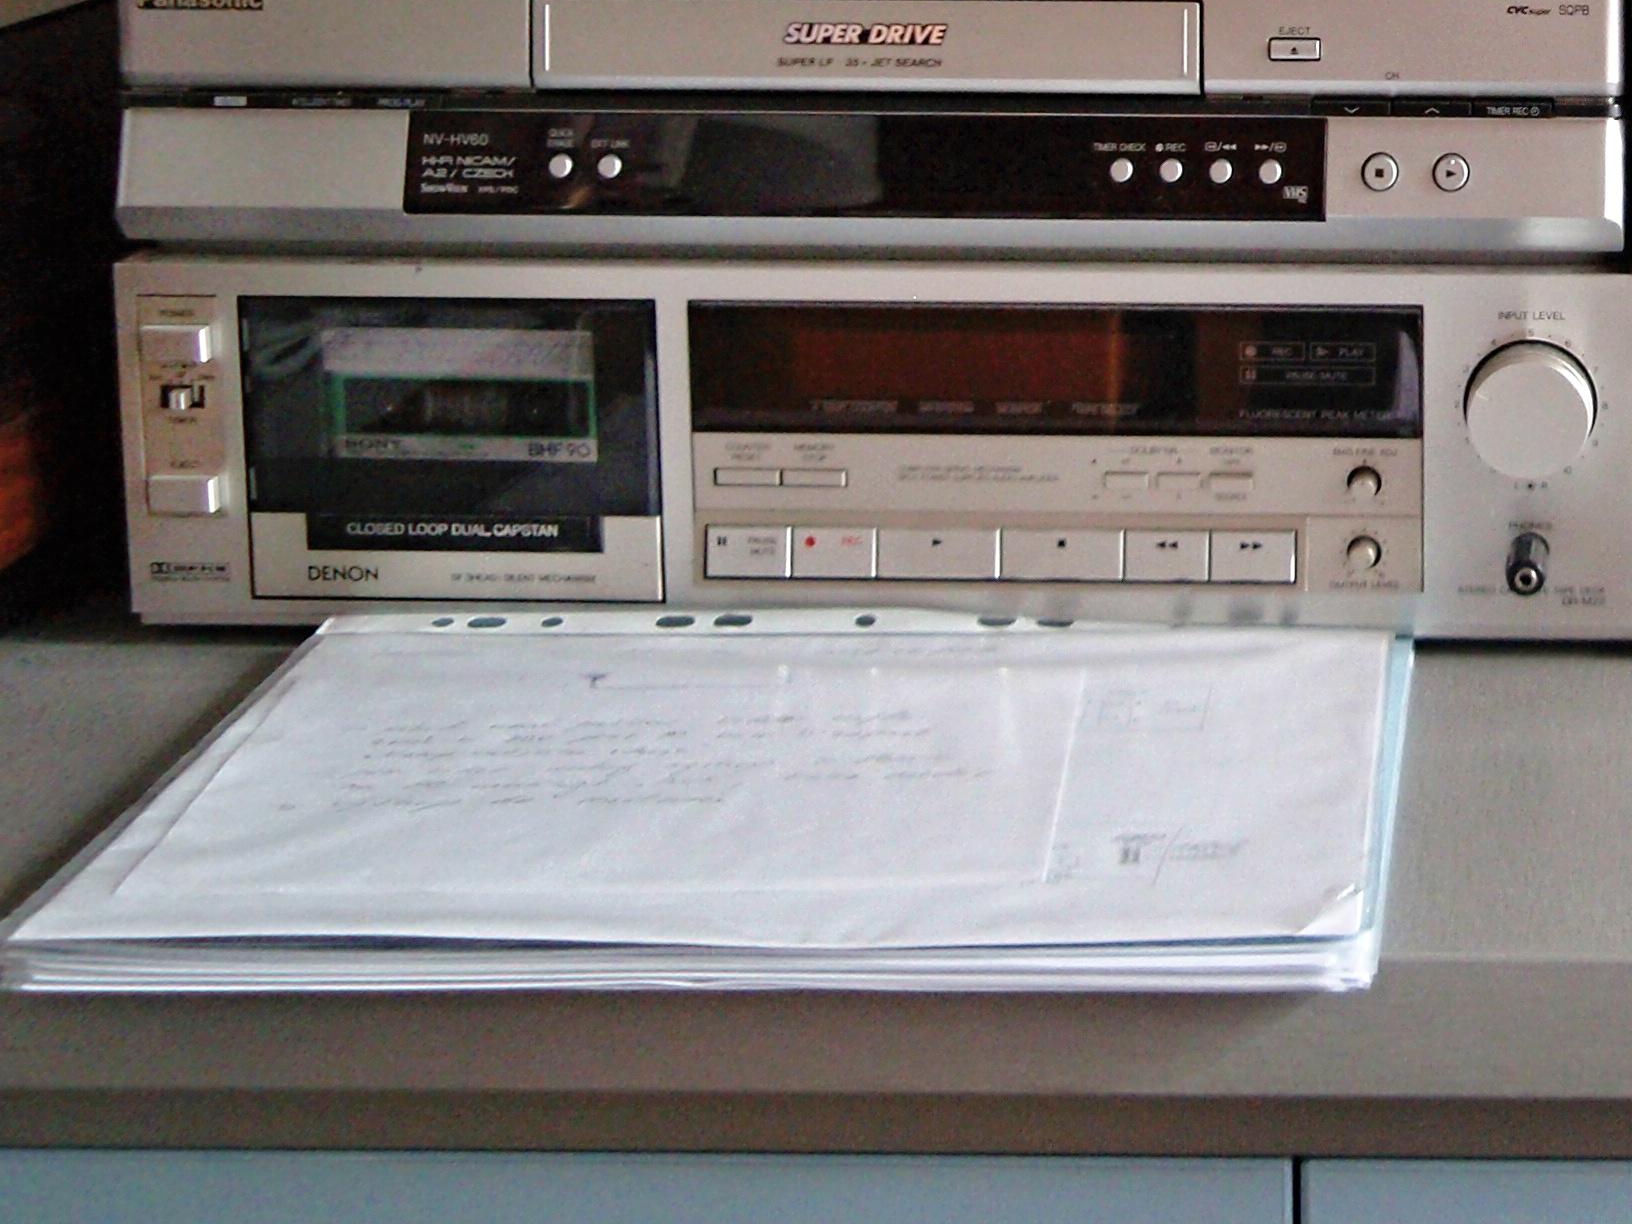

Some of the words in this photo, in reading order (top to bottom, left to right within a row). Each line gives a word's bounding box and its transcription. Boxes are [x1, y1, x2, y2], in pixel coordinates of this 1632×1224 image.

[784, 22, 863, 44] SUPER
[868, 23, 947, 45] DRIVE
[1279, 27, 1310, 35] EJECT
[777, 58, 816, 67] SUPER
[895, 58, 941, 67] SEARCH
[1513, 107, 1529, 115] REC
[1164, 143, 1186, 151] REC
[456, 156, 517, 165] NICAM/
[462, 169, 513, 178] CZECH
[1283, 186, 1309, 204] VHS
[1498, 312, 1528, 320] INPUT
[1532, 312, 1565, 320] LEVEL
[347, 524, 404, 536] CLOSED
[408, 524, 448, 536] LOOP
[452, 524, 490, 536] DUAL
[494, 524, 558, 537] CAPSTAN
[308, 566, 378, 580] DENON
